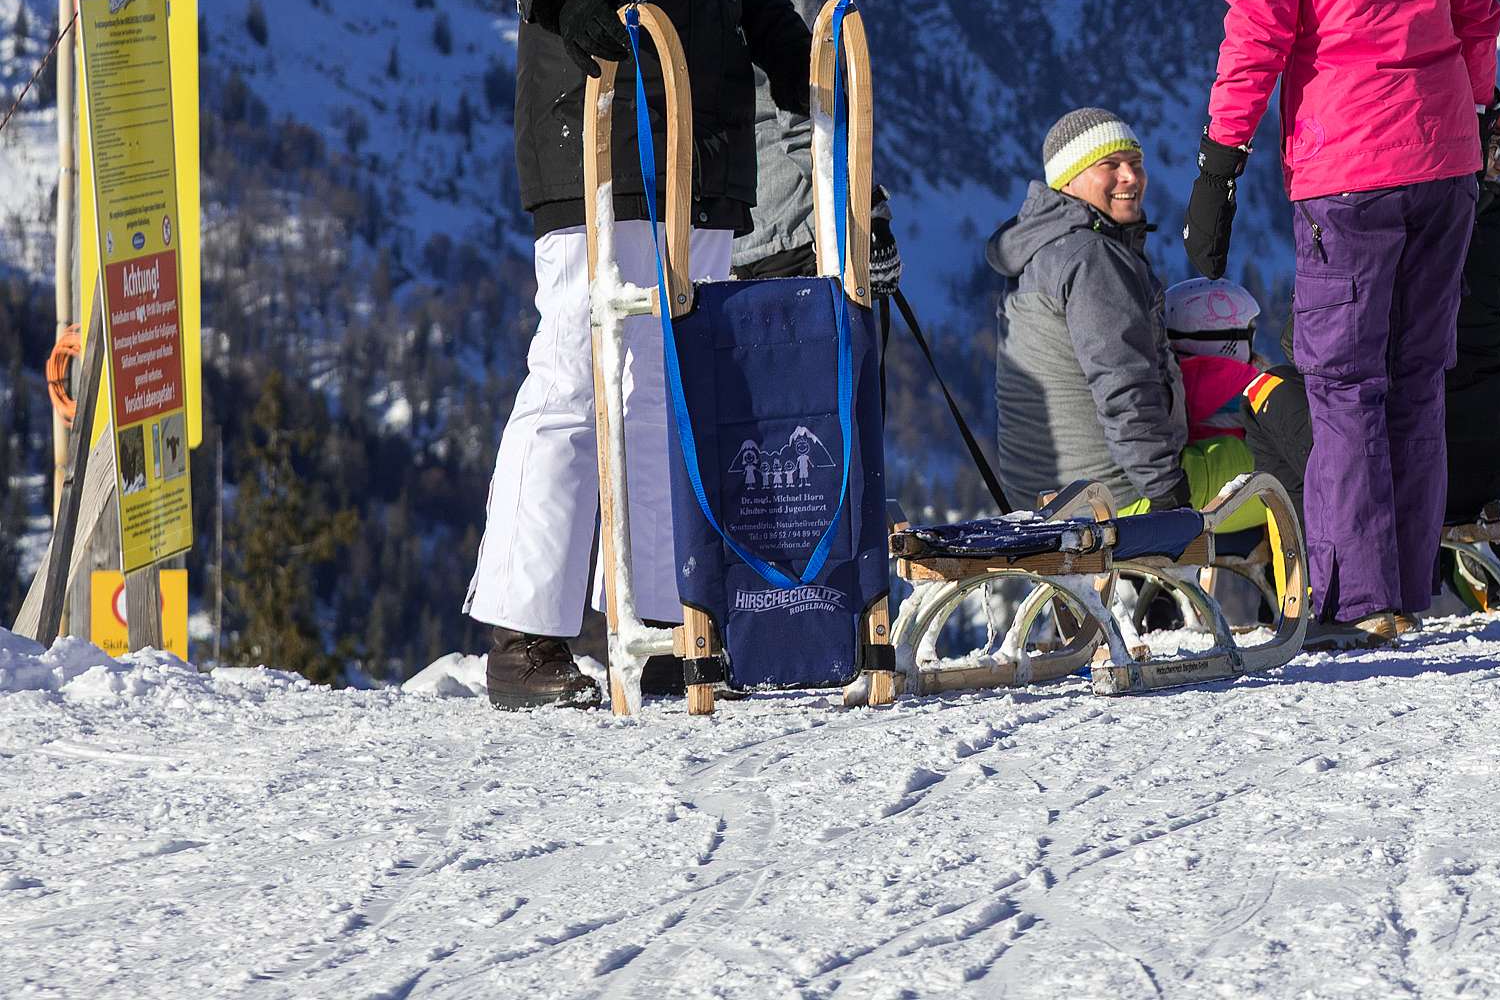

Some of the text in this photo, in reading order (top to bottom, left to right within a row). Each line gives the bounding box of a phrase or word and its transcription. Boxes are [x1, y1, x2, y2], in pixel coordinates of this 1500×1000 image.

[122, 258, 160, 299] Achtung!
[741, 496, 753, 505] Dr.
[773, 493, 802, 503] Michael
[803, 493, 824, 501] Horn
[768, 505, 783, 514] und
[784, 503, 827, 514] Jugendarzt
[776, 519, 832, 529] Naturheilverfahr
[735, 587, 843, 609] HIRSCHECKBLITZ
[789, 602, 837, 616] RODELBAHN
